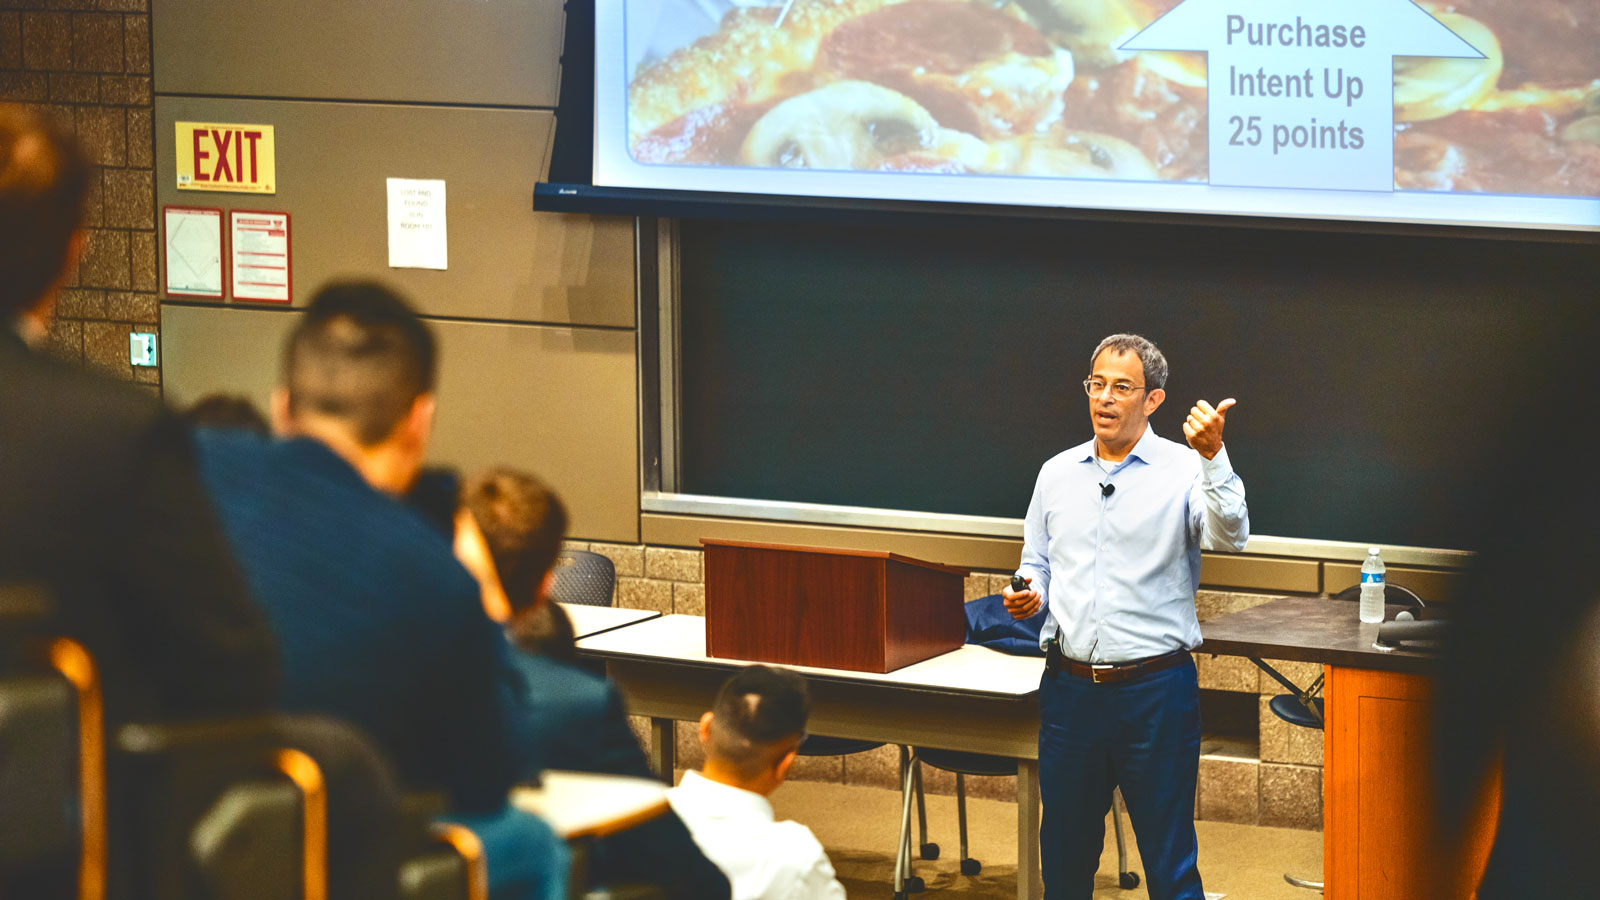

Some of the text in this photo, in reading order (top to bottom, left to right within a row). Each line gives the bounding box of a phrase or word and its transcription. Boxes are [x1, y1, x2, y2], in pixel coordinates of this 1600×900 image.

[1226, 14, 1367, 49] Purchase
[1229, 65, 1364, 107] Intent Up
[1228, 115, 1365, 155] 25 points
[193, 128, 262, 184] EXIT
